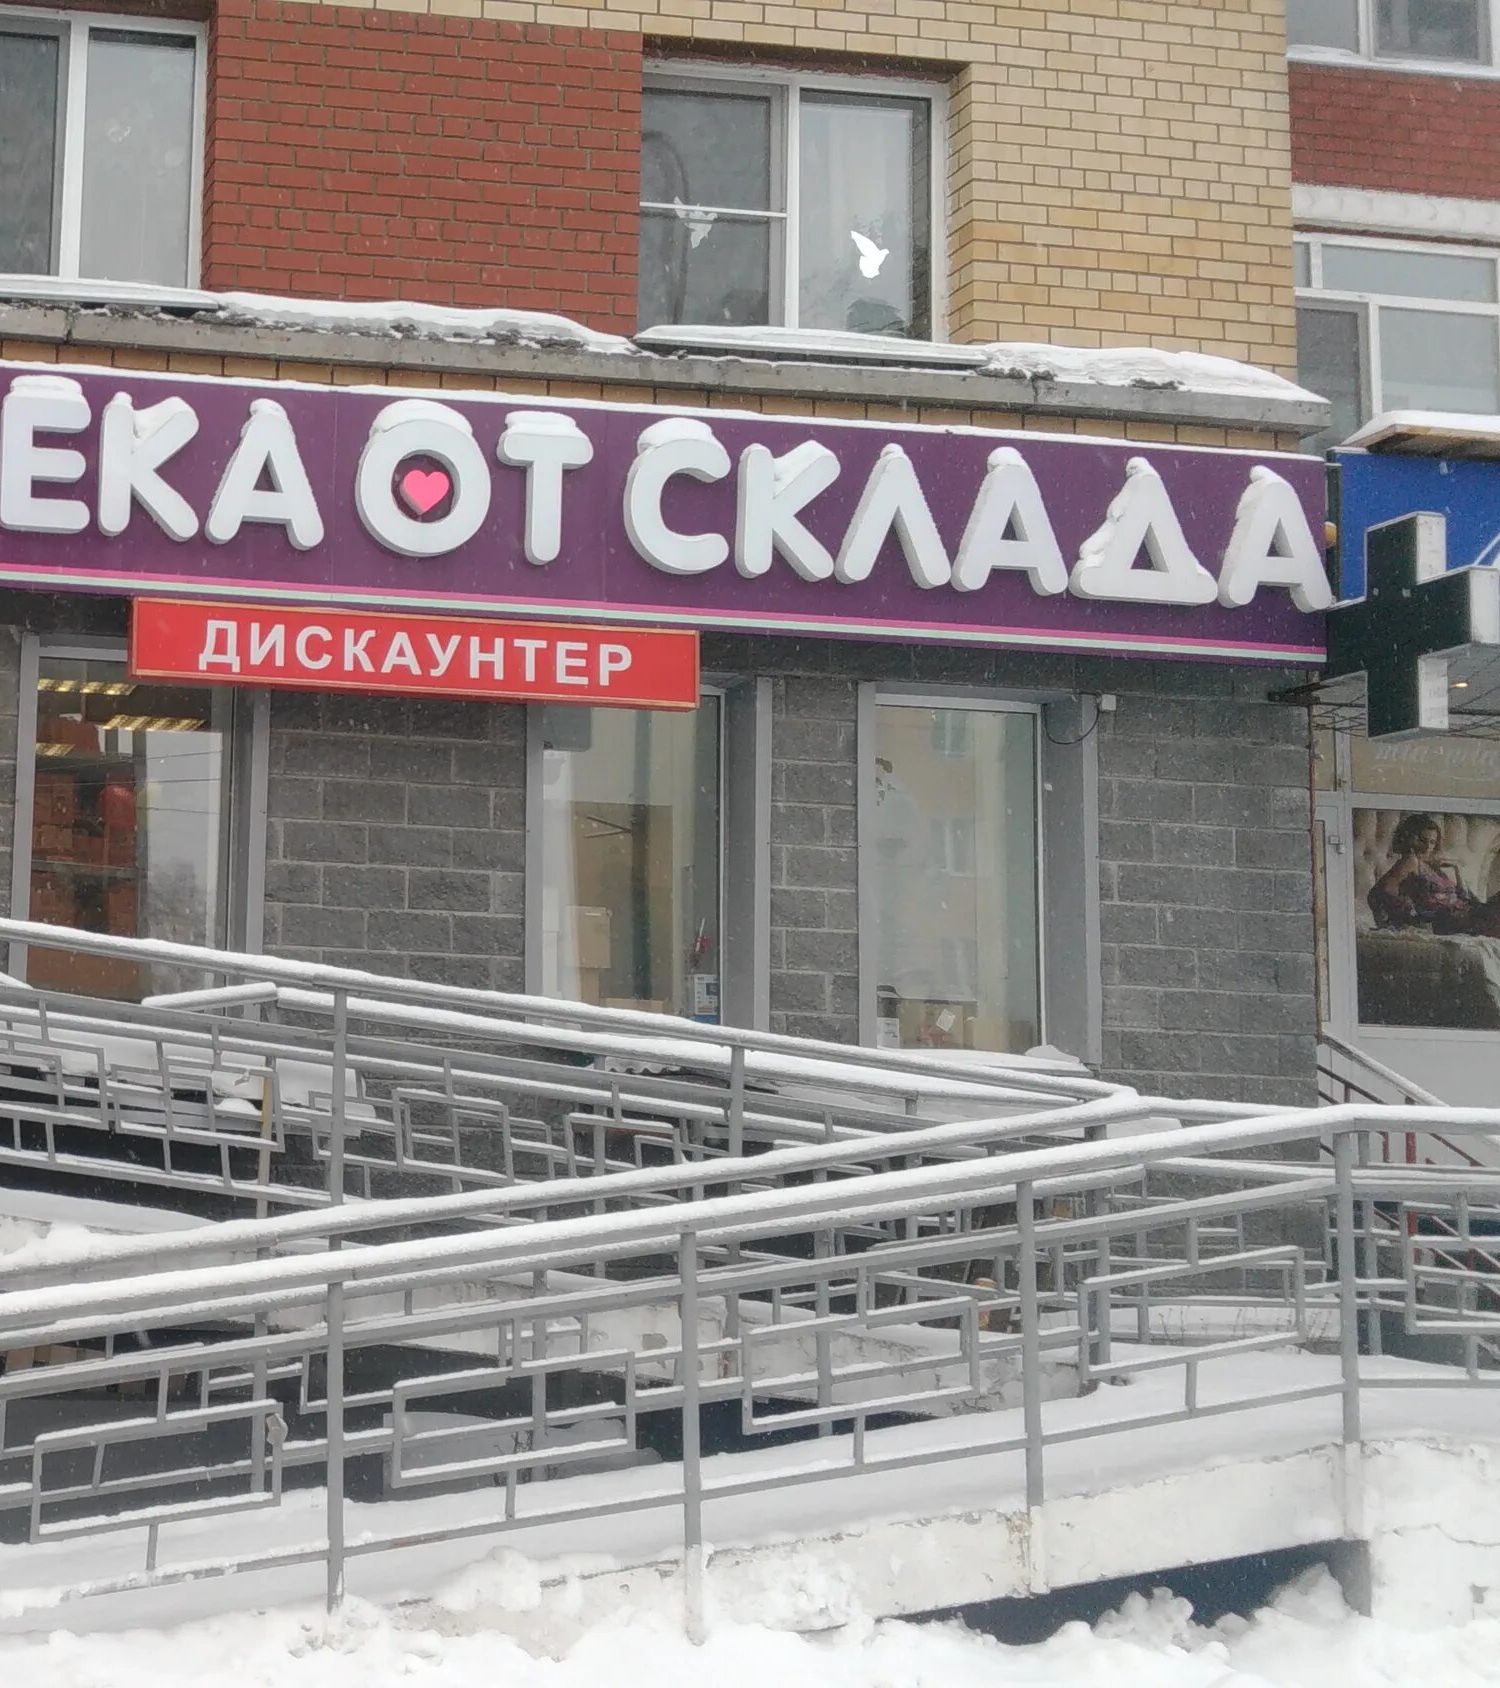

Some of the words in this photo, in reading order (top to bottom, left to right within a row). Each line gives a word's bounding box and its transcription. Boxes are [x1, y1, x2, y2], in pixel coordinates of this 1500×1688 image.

[355, 400, 594, 566] ОТ
[624, 418, 1334, 612] СКЛАДА
[199, 620, 633, 687] ДИСКАУНТЕР
